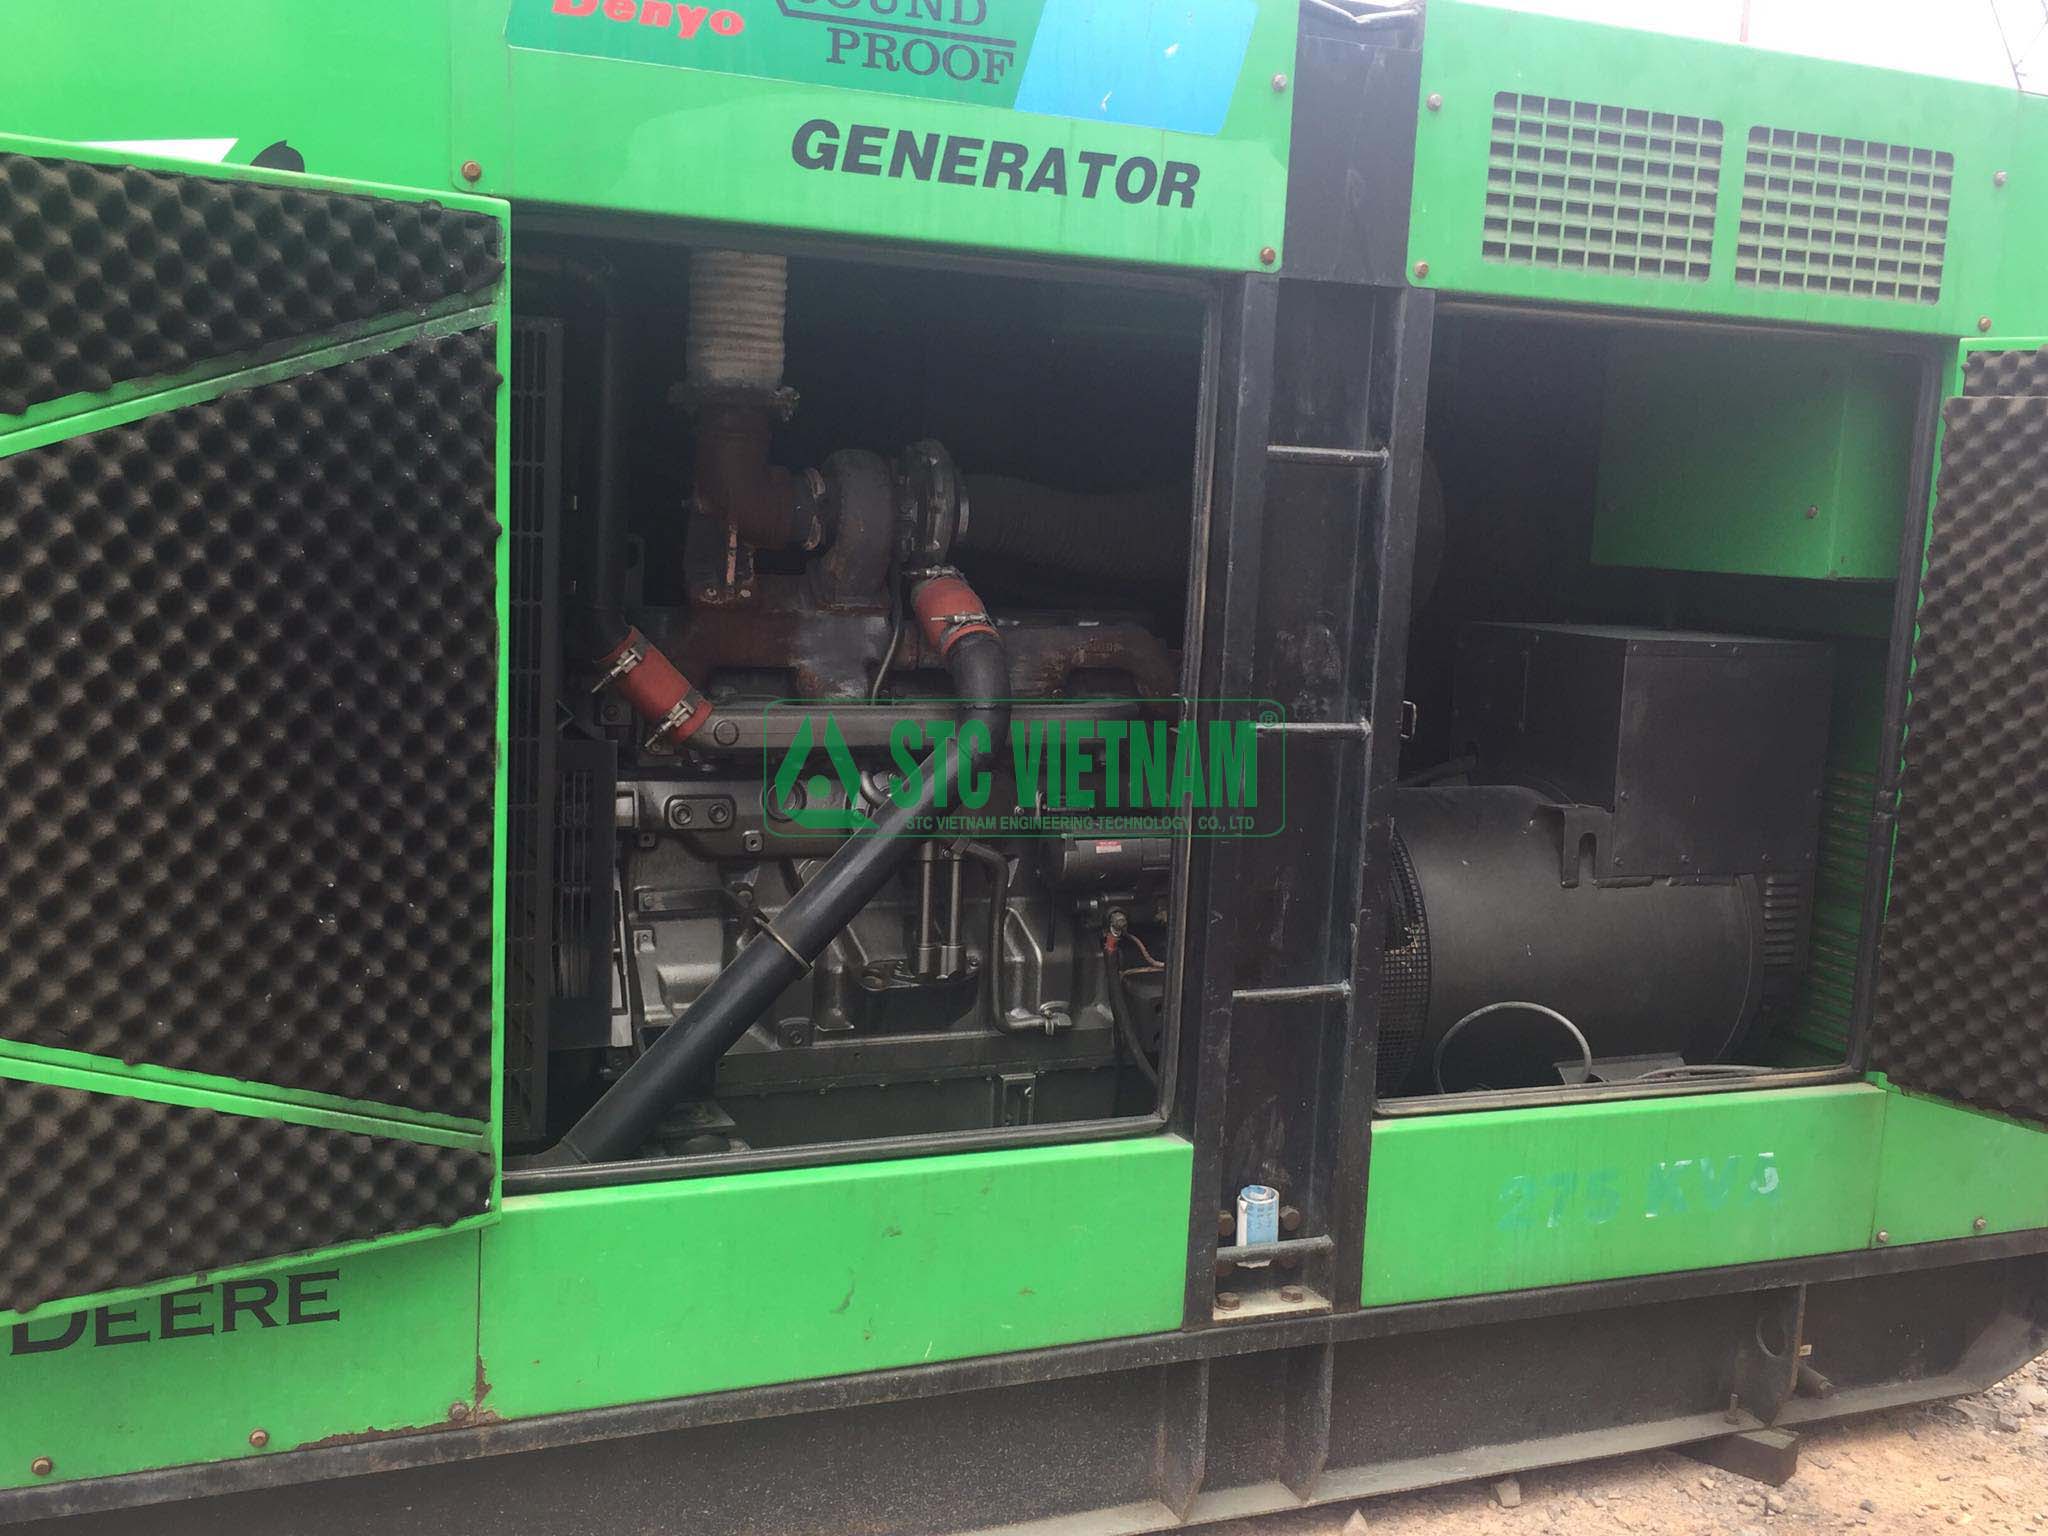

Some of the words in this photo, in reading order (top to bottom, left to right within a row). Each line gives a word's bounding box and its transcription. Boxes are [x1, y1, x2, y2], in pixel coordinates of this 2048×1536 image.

[826, 27, 1014, 85] PROOF
[792, 118, 1201, 209] GENERATOR
[10, 1268, 340, 1356] DEERE
